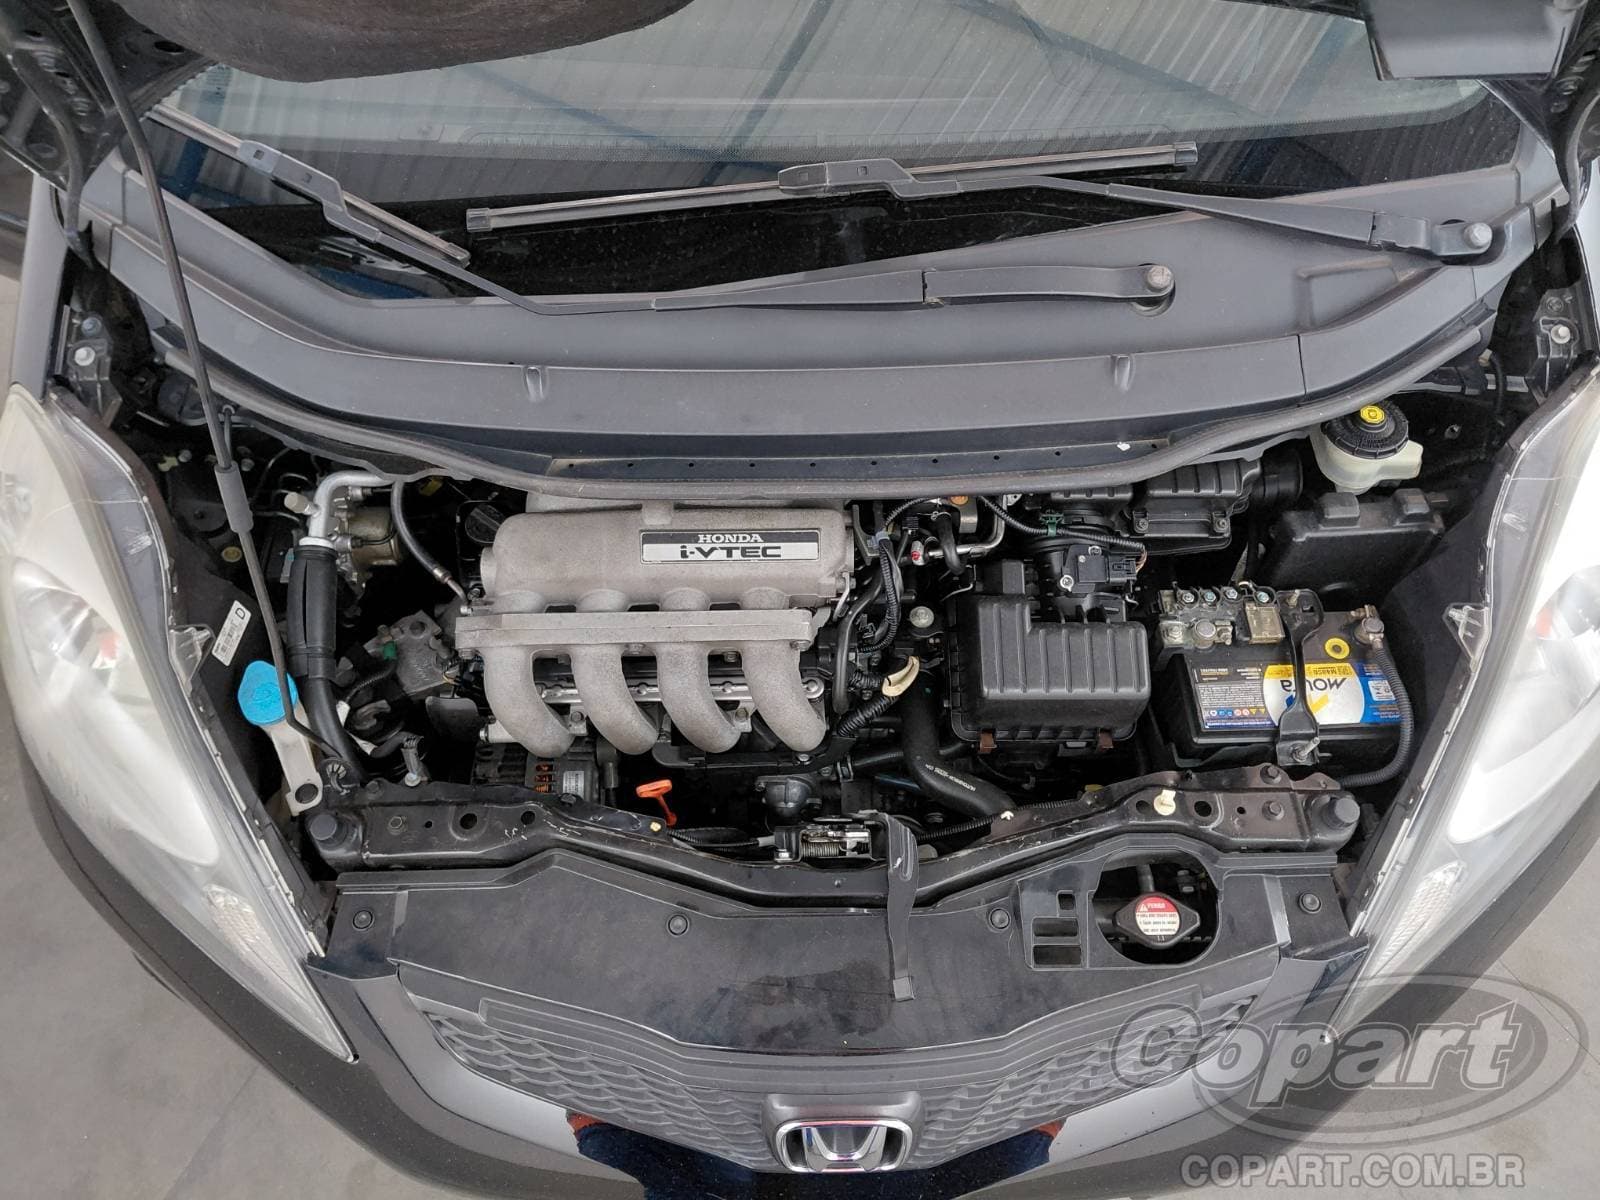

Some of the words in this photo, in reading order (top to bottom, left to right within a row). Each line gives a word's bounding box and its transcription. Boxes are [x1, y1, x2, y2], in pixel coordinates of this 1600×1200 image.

[698, 534, 764, 544] HONDA
[680, 545, 782, 559] i-VTEC
[1280, 678, 1347, 692] Moua
